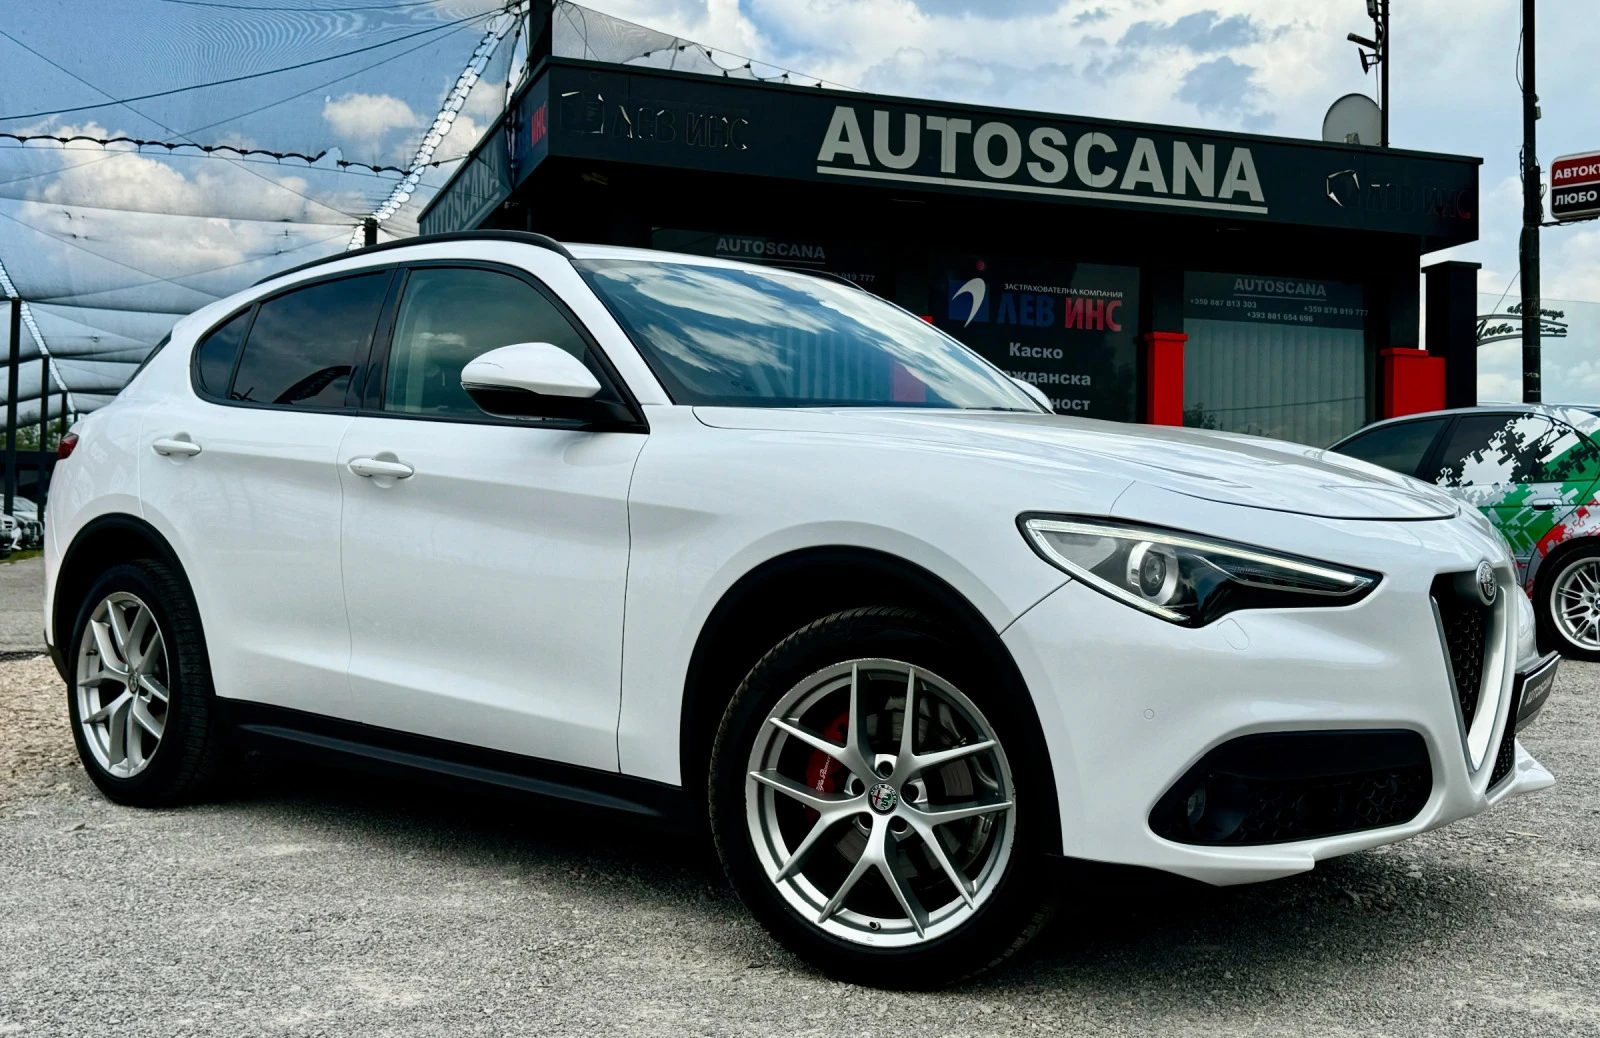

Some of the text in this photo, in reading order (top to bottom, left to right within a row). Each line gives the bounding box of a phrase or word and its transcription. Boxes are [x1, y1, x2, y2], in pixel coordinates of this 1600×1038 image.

[817, 106, 1265, 202] AUTOSCANA
[1554, 190, 1598, 206] ЛЮБО
[716, 238, 826, 259] AUTOSCANA
[1004, 283, 1123, 298] ЗАСТРАХОВАТЕЛНА КОМПАНИЯ
[1233, 278, 1327, 297] AUTOSCANA
[997, 292, 1122, 332] ЛЕВ ИНС
[1242, 301, 1257, 309] 303
[1009, 342, 1063, 359] Каско
